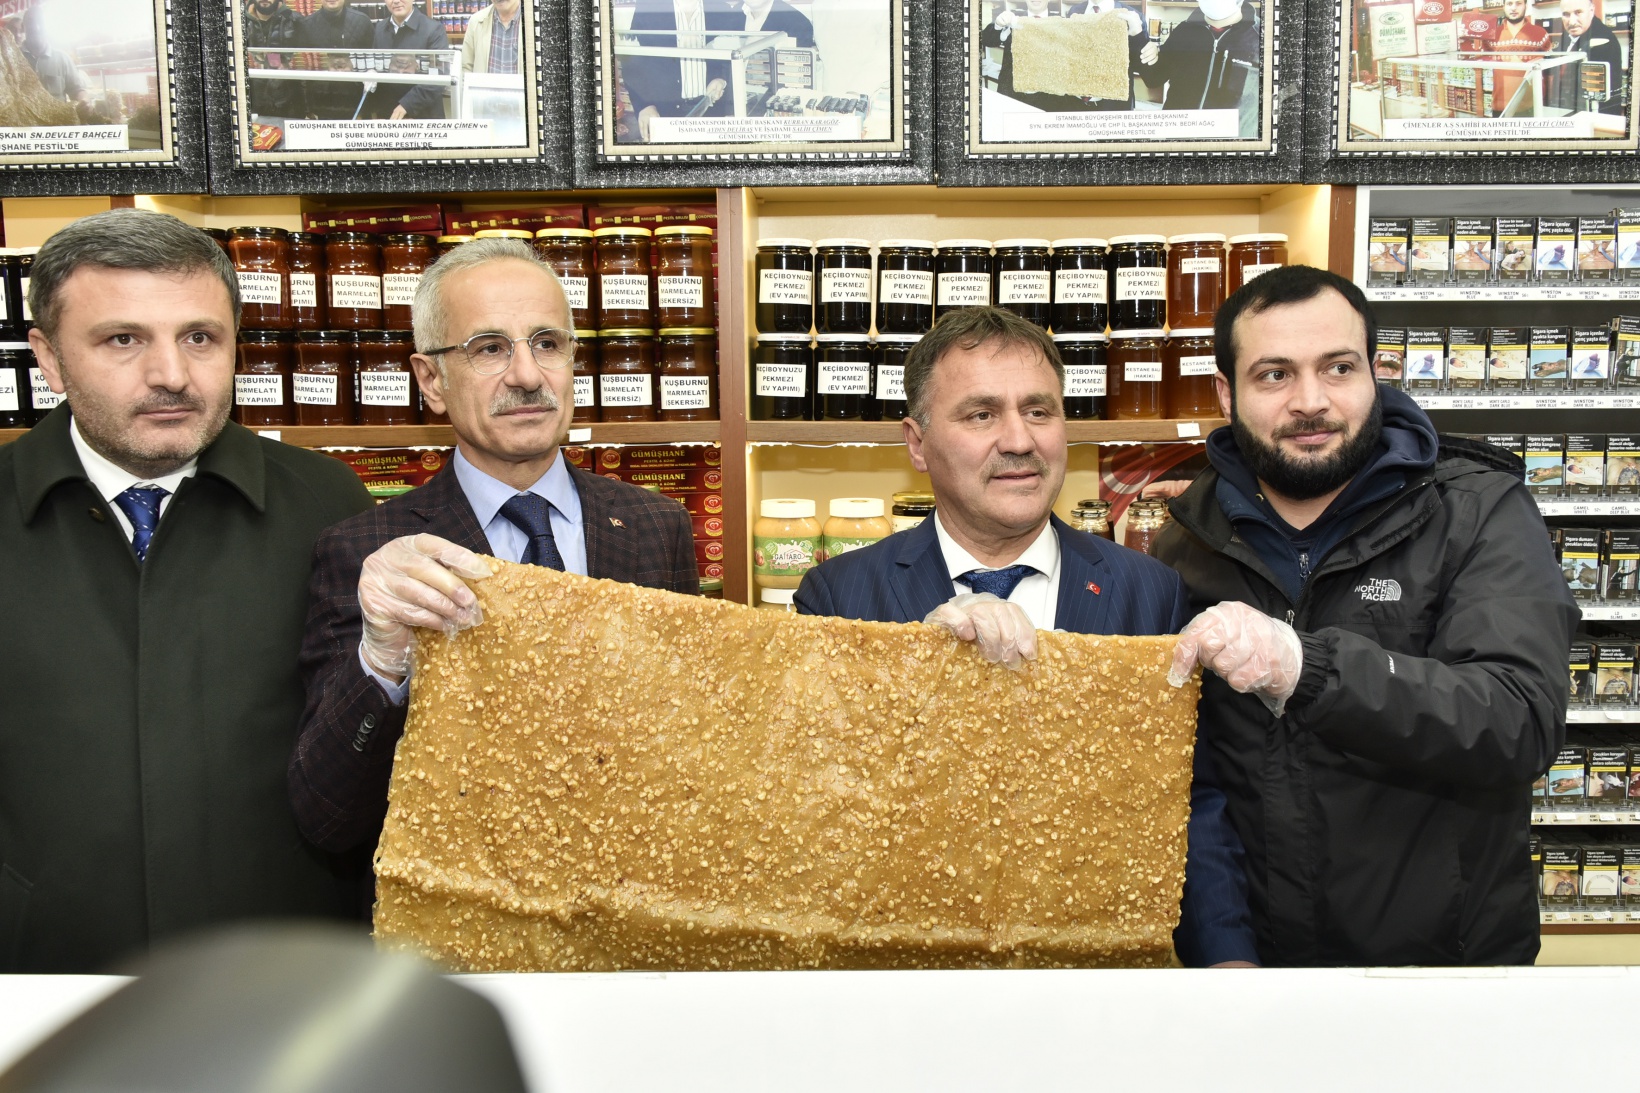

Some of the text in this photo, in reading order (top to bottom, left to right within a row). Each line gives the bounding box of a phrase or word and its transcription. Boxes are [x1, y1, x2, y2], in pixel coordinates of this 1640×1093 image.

[289, 122, 336, 130] GÜMÜŞHANE
[454, 122, 478, 130] ÇİMEN
[30, 131, 79, 139] SN.DEVLET
[82, 130, 122, 139] BAHÇELİ
[1446, 129, 1493, 137] GÜMÜŞHANE
[345, 141, 393, 149] GÜMÜŞHANE
[765, 272, 812, 281] KEÇİBOYNUZU
[824, 271, 870, 280] KEÇİBOYNUZU
[885, 273, 932, 281] KEÇİBOYNUZU
[1118, 270, 1165, 278] KEÇİBOYNUZU
[942, 275, 990, 283] KEÇİBOYNUZU
[774, 282, 805, 290] PEKMEZİ
[246, 294, 277, 302] YAPIMI)
[337, 290, 378, 298] MARMELATI
[757, 365, 803, 374] KEÇİBOYNUZU
[294, 376, 335, 384] KUŞBURNU
[37, 397, 59, 405] (DUT)
[631, 450, 685, 459] GÜMÜŞHANE
[356, 456, 408, 465] GÜMÜŞHANE
[631, 473, 685, 482] GÜMÜŞHANE
[1369, 578, 1388, 586] THE
[1354, 585, 1387, 593] NORTH
[1361, 593, 1386, 601] FACE
